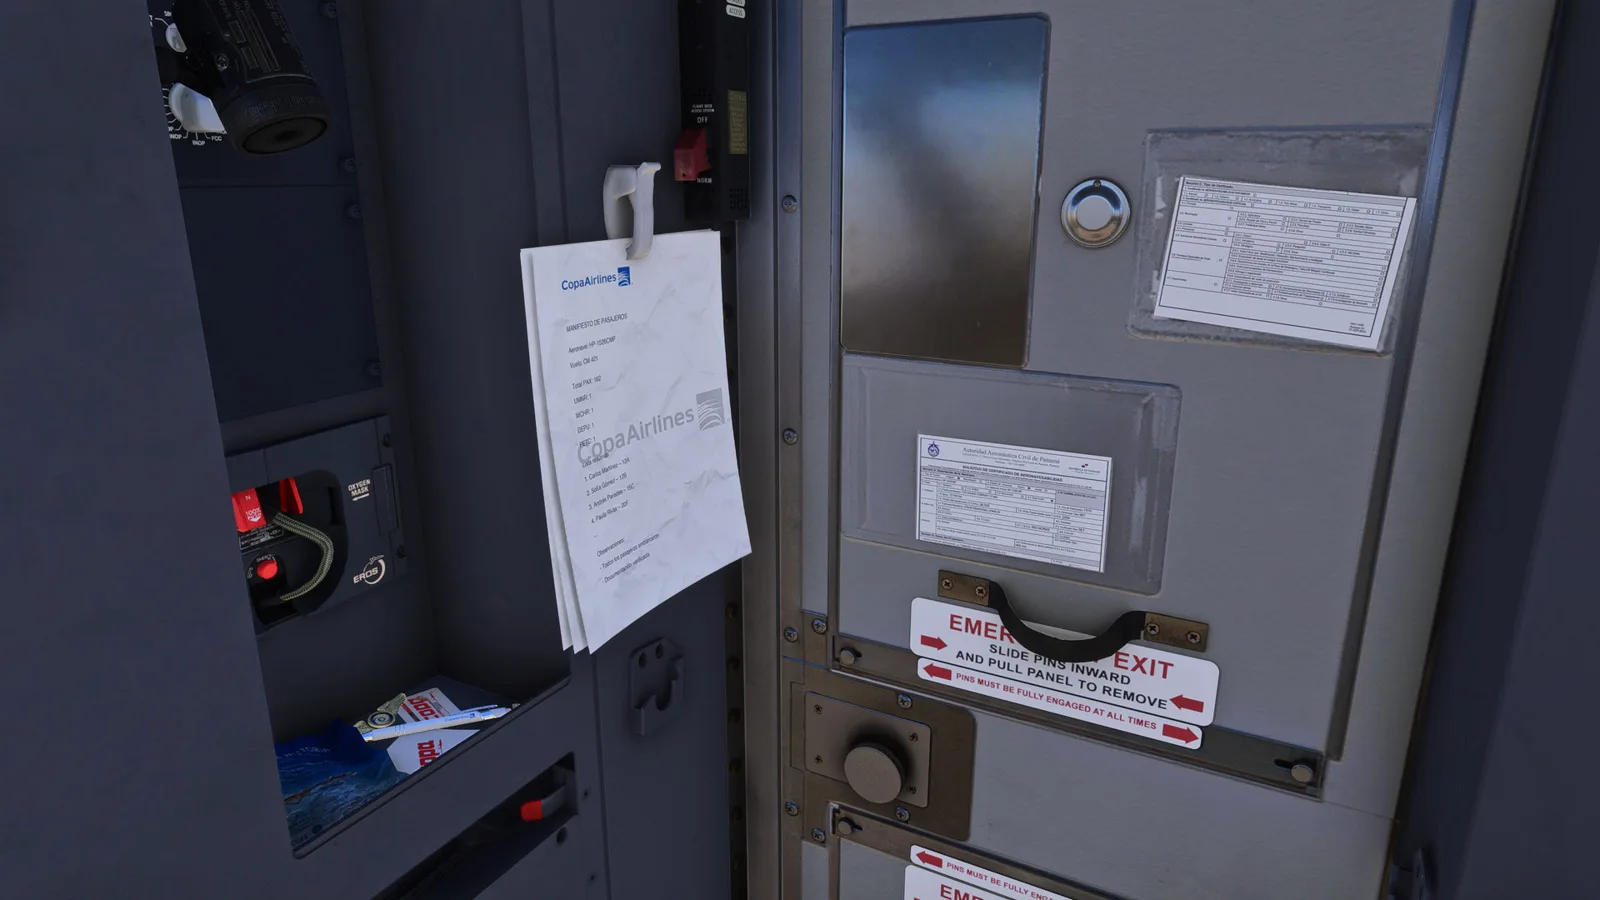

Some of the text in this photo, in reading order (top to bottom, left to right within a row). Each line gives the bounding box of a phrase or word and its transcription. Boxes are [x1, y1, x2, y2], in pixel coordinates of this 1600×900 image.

[561, 273, 617, 290] CopaAirlines
[566, 313, 628, 332] MANIFIESTO DE PASAJEROS
[568, 344, 588, 354] Aeronave:
[572, 382, 582, 390] Total
[583, 378, 593, 386] PAX:
[577, 408, 695, 466] CopaAirlines
[963, 447, 986, 455] Autoridad
[589, 470, 601, 480] Carlos
[348, 479, 370, 491] OXYGEN
[351, 486, 369, 497] MASK
[602, 559, 614, 569] Todos
[620, 545, 637, 559] pasajeros
[638, 533, 660, 548] embarcaron
[353, 567, 378, 584] EROS
[989, 644, 1131, 685] SLIDE PINS INWARD
[1113, 651, 1174, 679] EXIT
[956, 650, 1168, 710] AND PULL PANEL TO REMOVE
[956, 673, 1157, 730] PINS MUST BE FULLY ENGAGED AT ALL TIMES
[946, 862, 965, 873] PINS
[966, 869, 988, 881] MUST
[990, 877, 1001, 886] BE
[1003, 880, 1029, 895] FULLY
